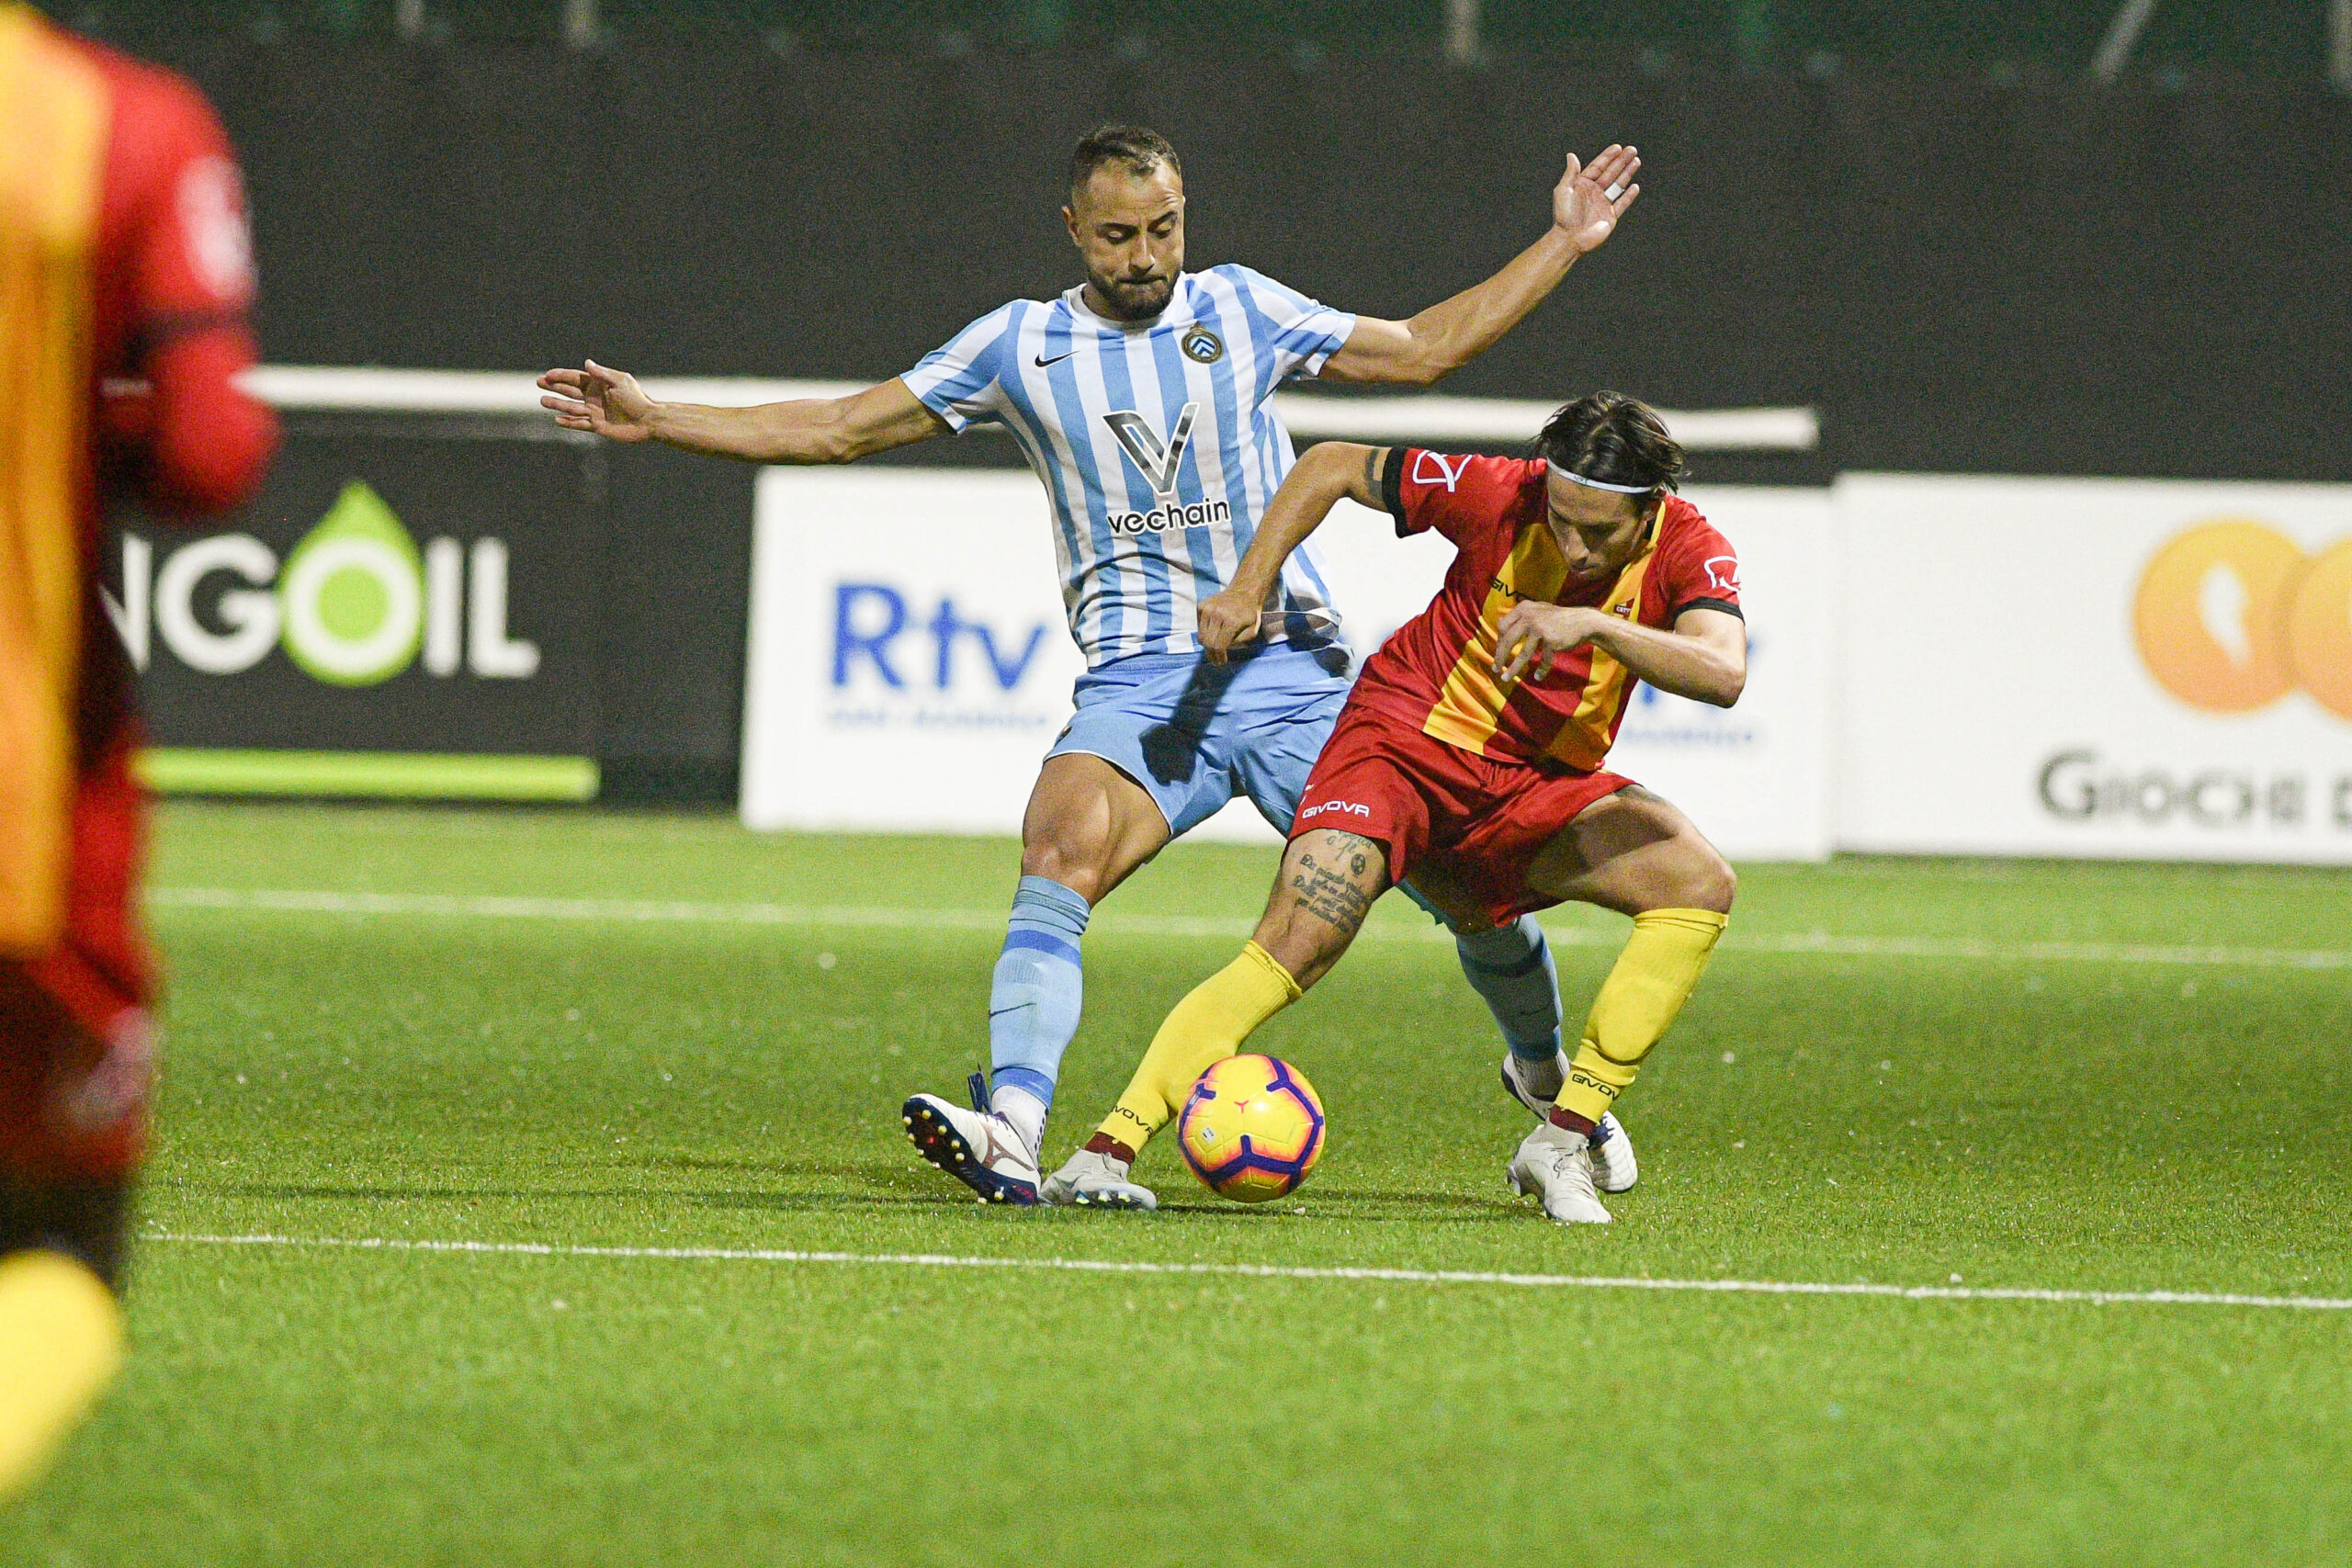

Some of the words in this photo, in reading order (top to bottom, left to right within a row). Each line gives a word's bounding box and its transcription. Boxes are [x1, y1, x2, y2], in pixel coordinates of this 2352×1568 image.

[1107, 497, 1229, 534] vechain
[831, 582, 1047, 690] Rtv
[1302, 800, 1370, 819] GIVOVA
